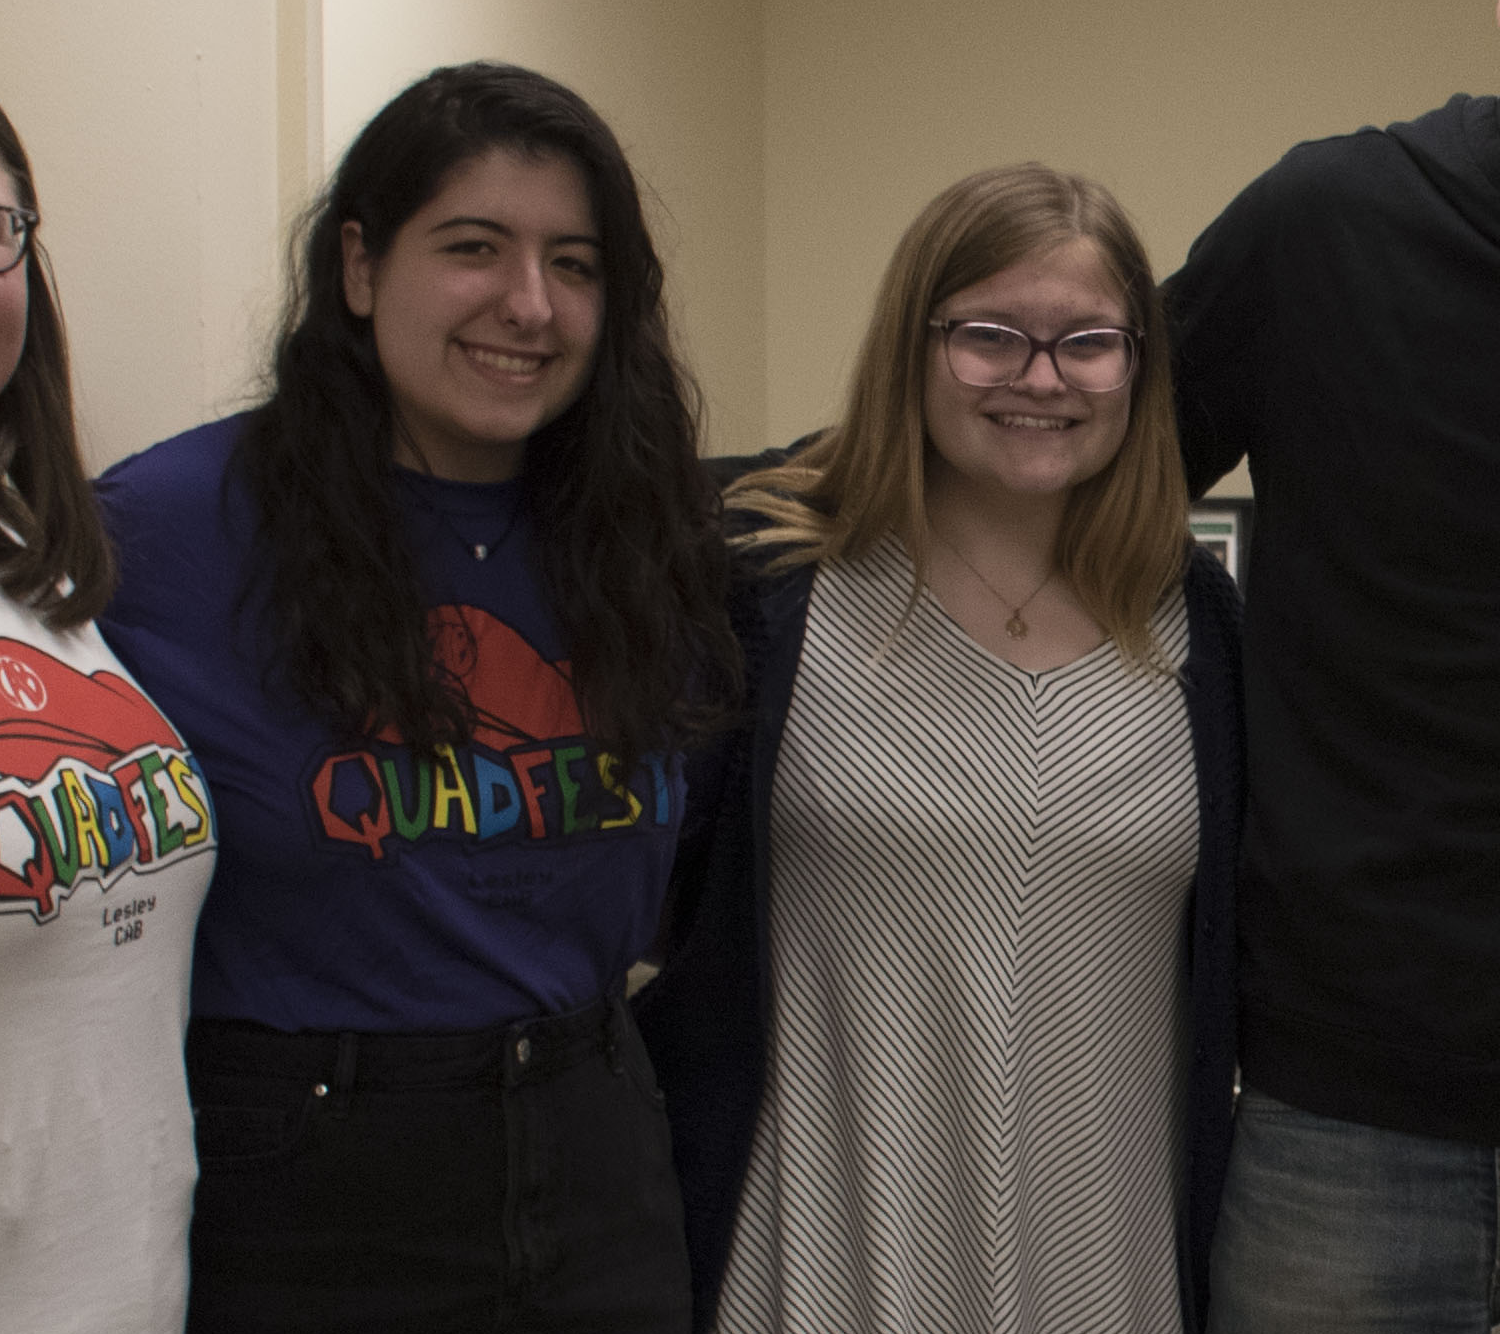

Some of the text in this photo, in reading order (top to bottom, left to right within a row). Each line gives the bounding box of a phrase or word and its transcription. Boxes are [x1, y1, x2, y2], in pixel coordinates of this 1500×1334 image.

[311, 744, 675, 860] QUADFEST
[103, 895, 157, 927] Lesley
[115, 919, 143, 946] CAB
